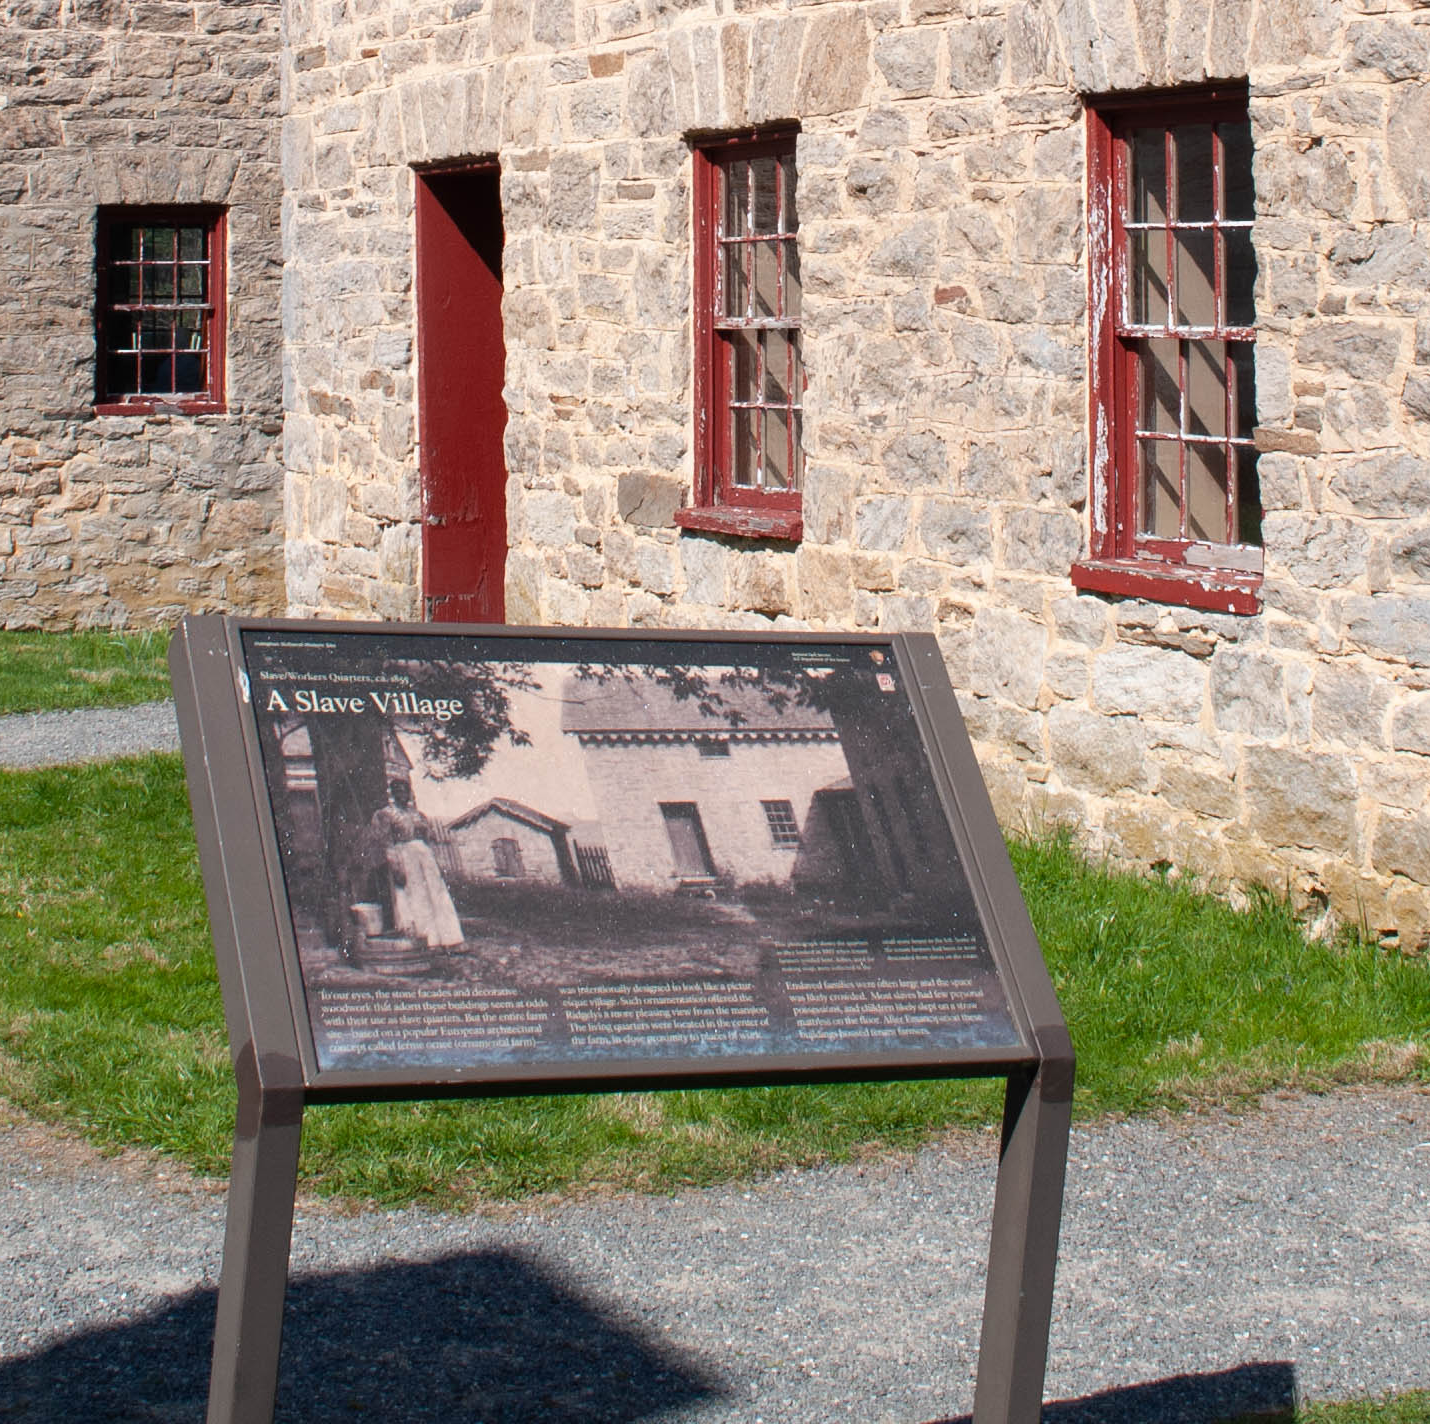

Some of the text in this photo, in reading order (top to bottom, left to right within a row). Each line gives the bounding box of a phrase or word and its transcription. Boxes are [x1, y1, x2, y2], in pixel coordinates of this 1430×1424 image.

[259, 671, 328, 681] Slave/Workers
[267, 690, 464, 721] A Slave Village
[559, 986, 577, 994] was
[633, 982, 671, 994] designed
[703, 981, 719, 991] like
[920, 978, 935, 987] and
[936, 978, 950, 986] the
[333, 991, 348, 1000] our
[375, 989, 390, 999] the
[392, 990, 416, 999] stone
[453, 987, 470, 998] and
[472, 986, 518, 997] decorative
[620, 996, 642, 1006] Such
[708, 993, 738, 1003] offered
[739, 993, 754, 1002] the
[917, 990, 933, 999] had
[322, 1003, 372, 1013] woodwork
[374, 1001, 391, 1012] that
[394, 1002, 421, 1011] adorn
[448, 1000, 489, 1013] buildings
[490, 1000, 514, 1009] seem
[526, 998, 548, 1008] odds
[323, 1016, 344, 1026] with
[346, 1016, 367, 1025] their
[370, 1017, 386, 1025] use
[399, 1014, 421, 1024] slave
[464, 1013, 480, 1022] But
[482, 1012, 497, 1022] the
[498, 1012, 525, 1022] entire
[526, 1010, 547, 1021] farm
[635, 1008, 672, 1020] pleasing
[672, 1008, 691, 1017] view
[693, 1006, 714, 1016] from
[715, 1006, 729, 1015] the
[381, 1030, 393, 1038] on
[402, 1027, 438, 1040] popular
[440, 1026, 485, 1037] European
[487, 1023, 542, 1037] architectural
[570, 1023, 587, 1032] The
[588, 1022, 612, 1033] living
[673, 1019, 705, 1029] located
[716, 1018, 731, 1027] the
[329, 1041, 367, 1054] concept
[368, 1039, 395, 1051] called
[571, 1035, 587, 1045] the
